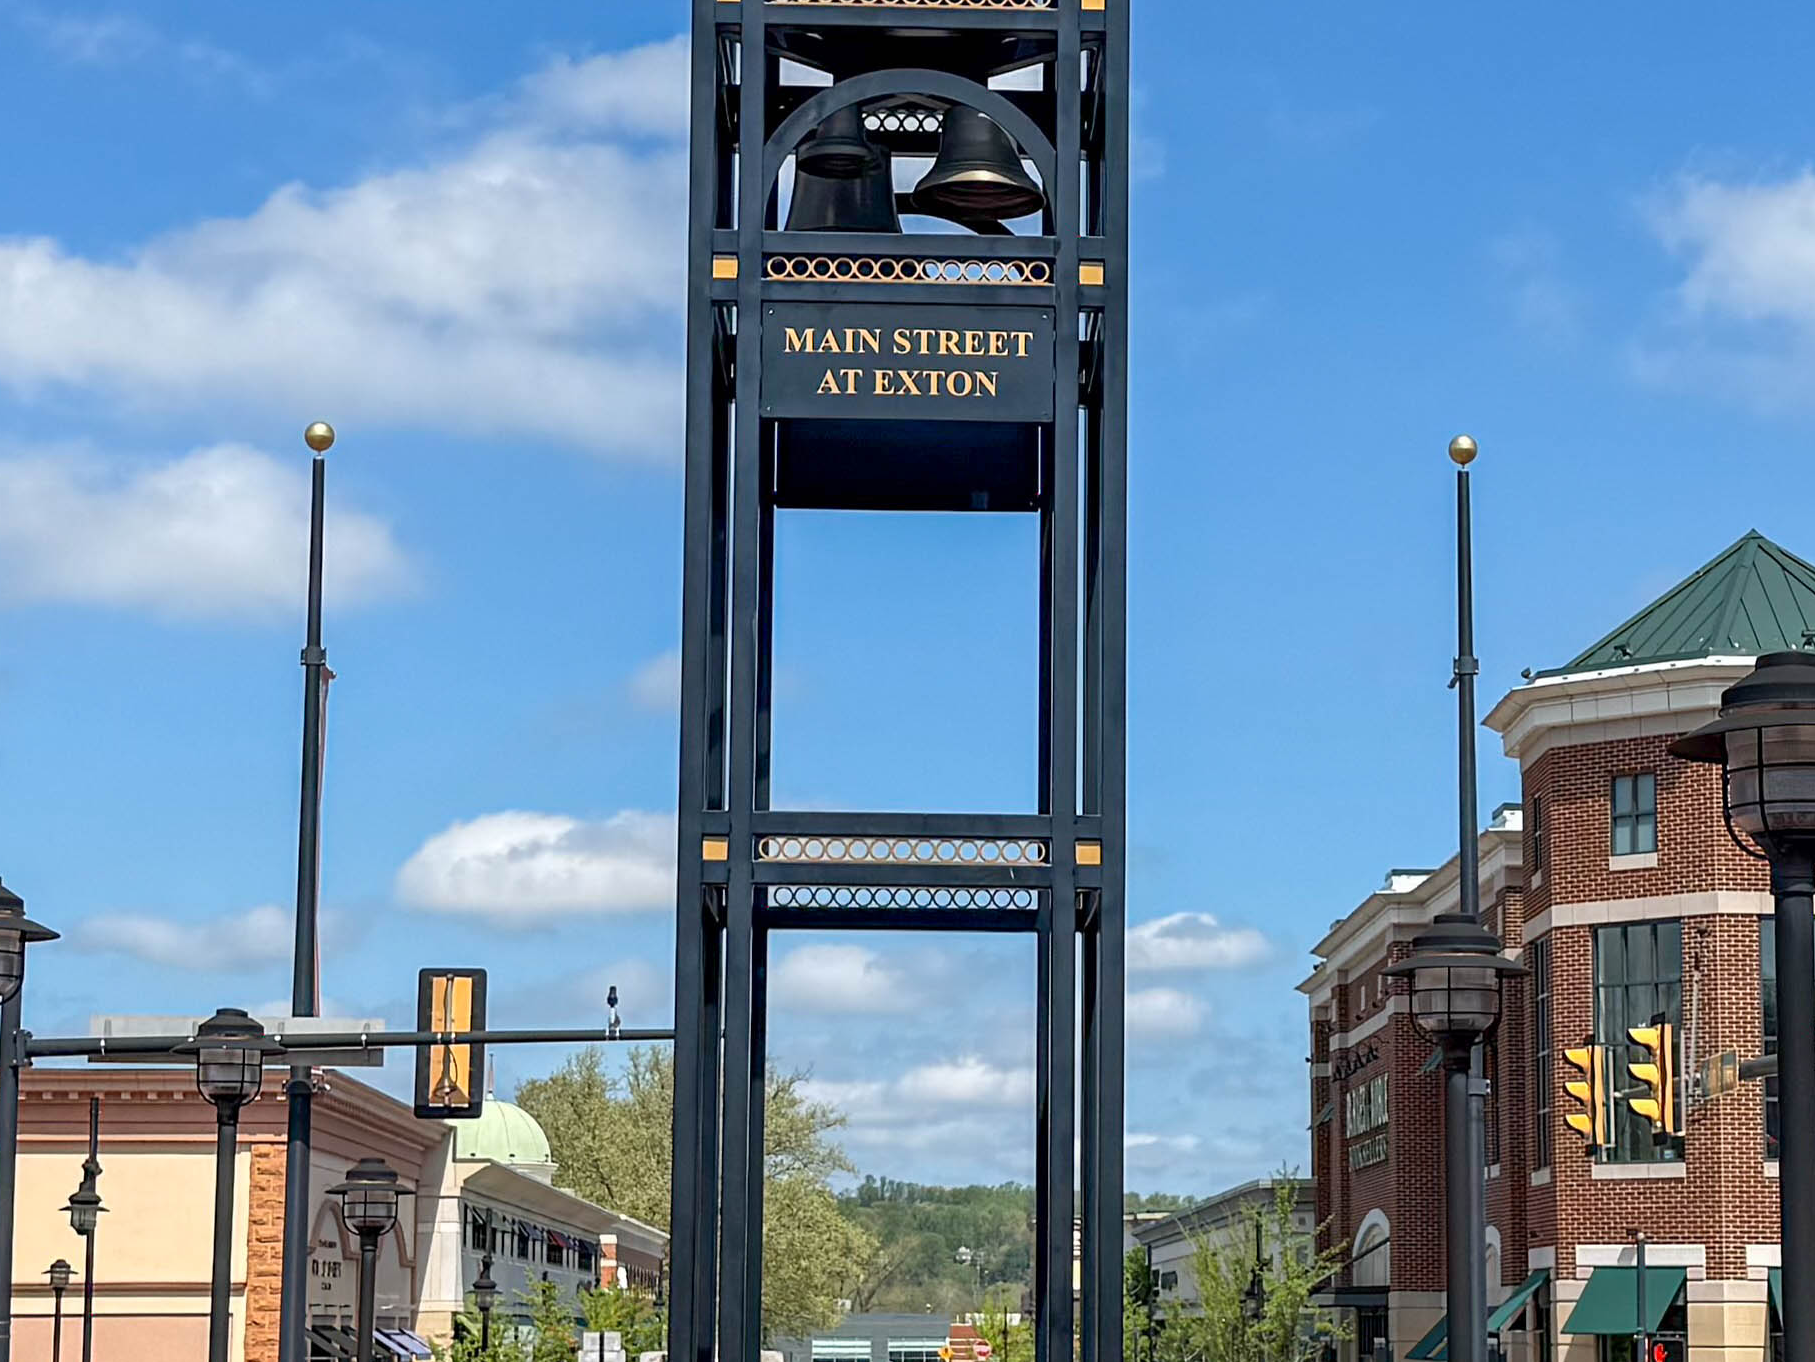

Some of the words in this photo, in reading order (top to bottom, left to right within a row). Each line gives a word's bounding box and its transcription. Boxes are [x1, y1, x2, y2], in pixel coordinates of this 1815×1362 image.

[784, 327, 881, 354] MAIN
[893, 328, 1034, 357] STREET
[816, 368, 863, 395] AT
[872, 369, 999, 397] EXTON
